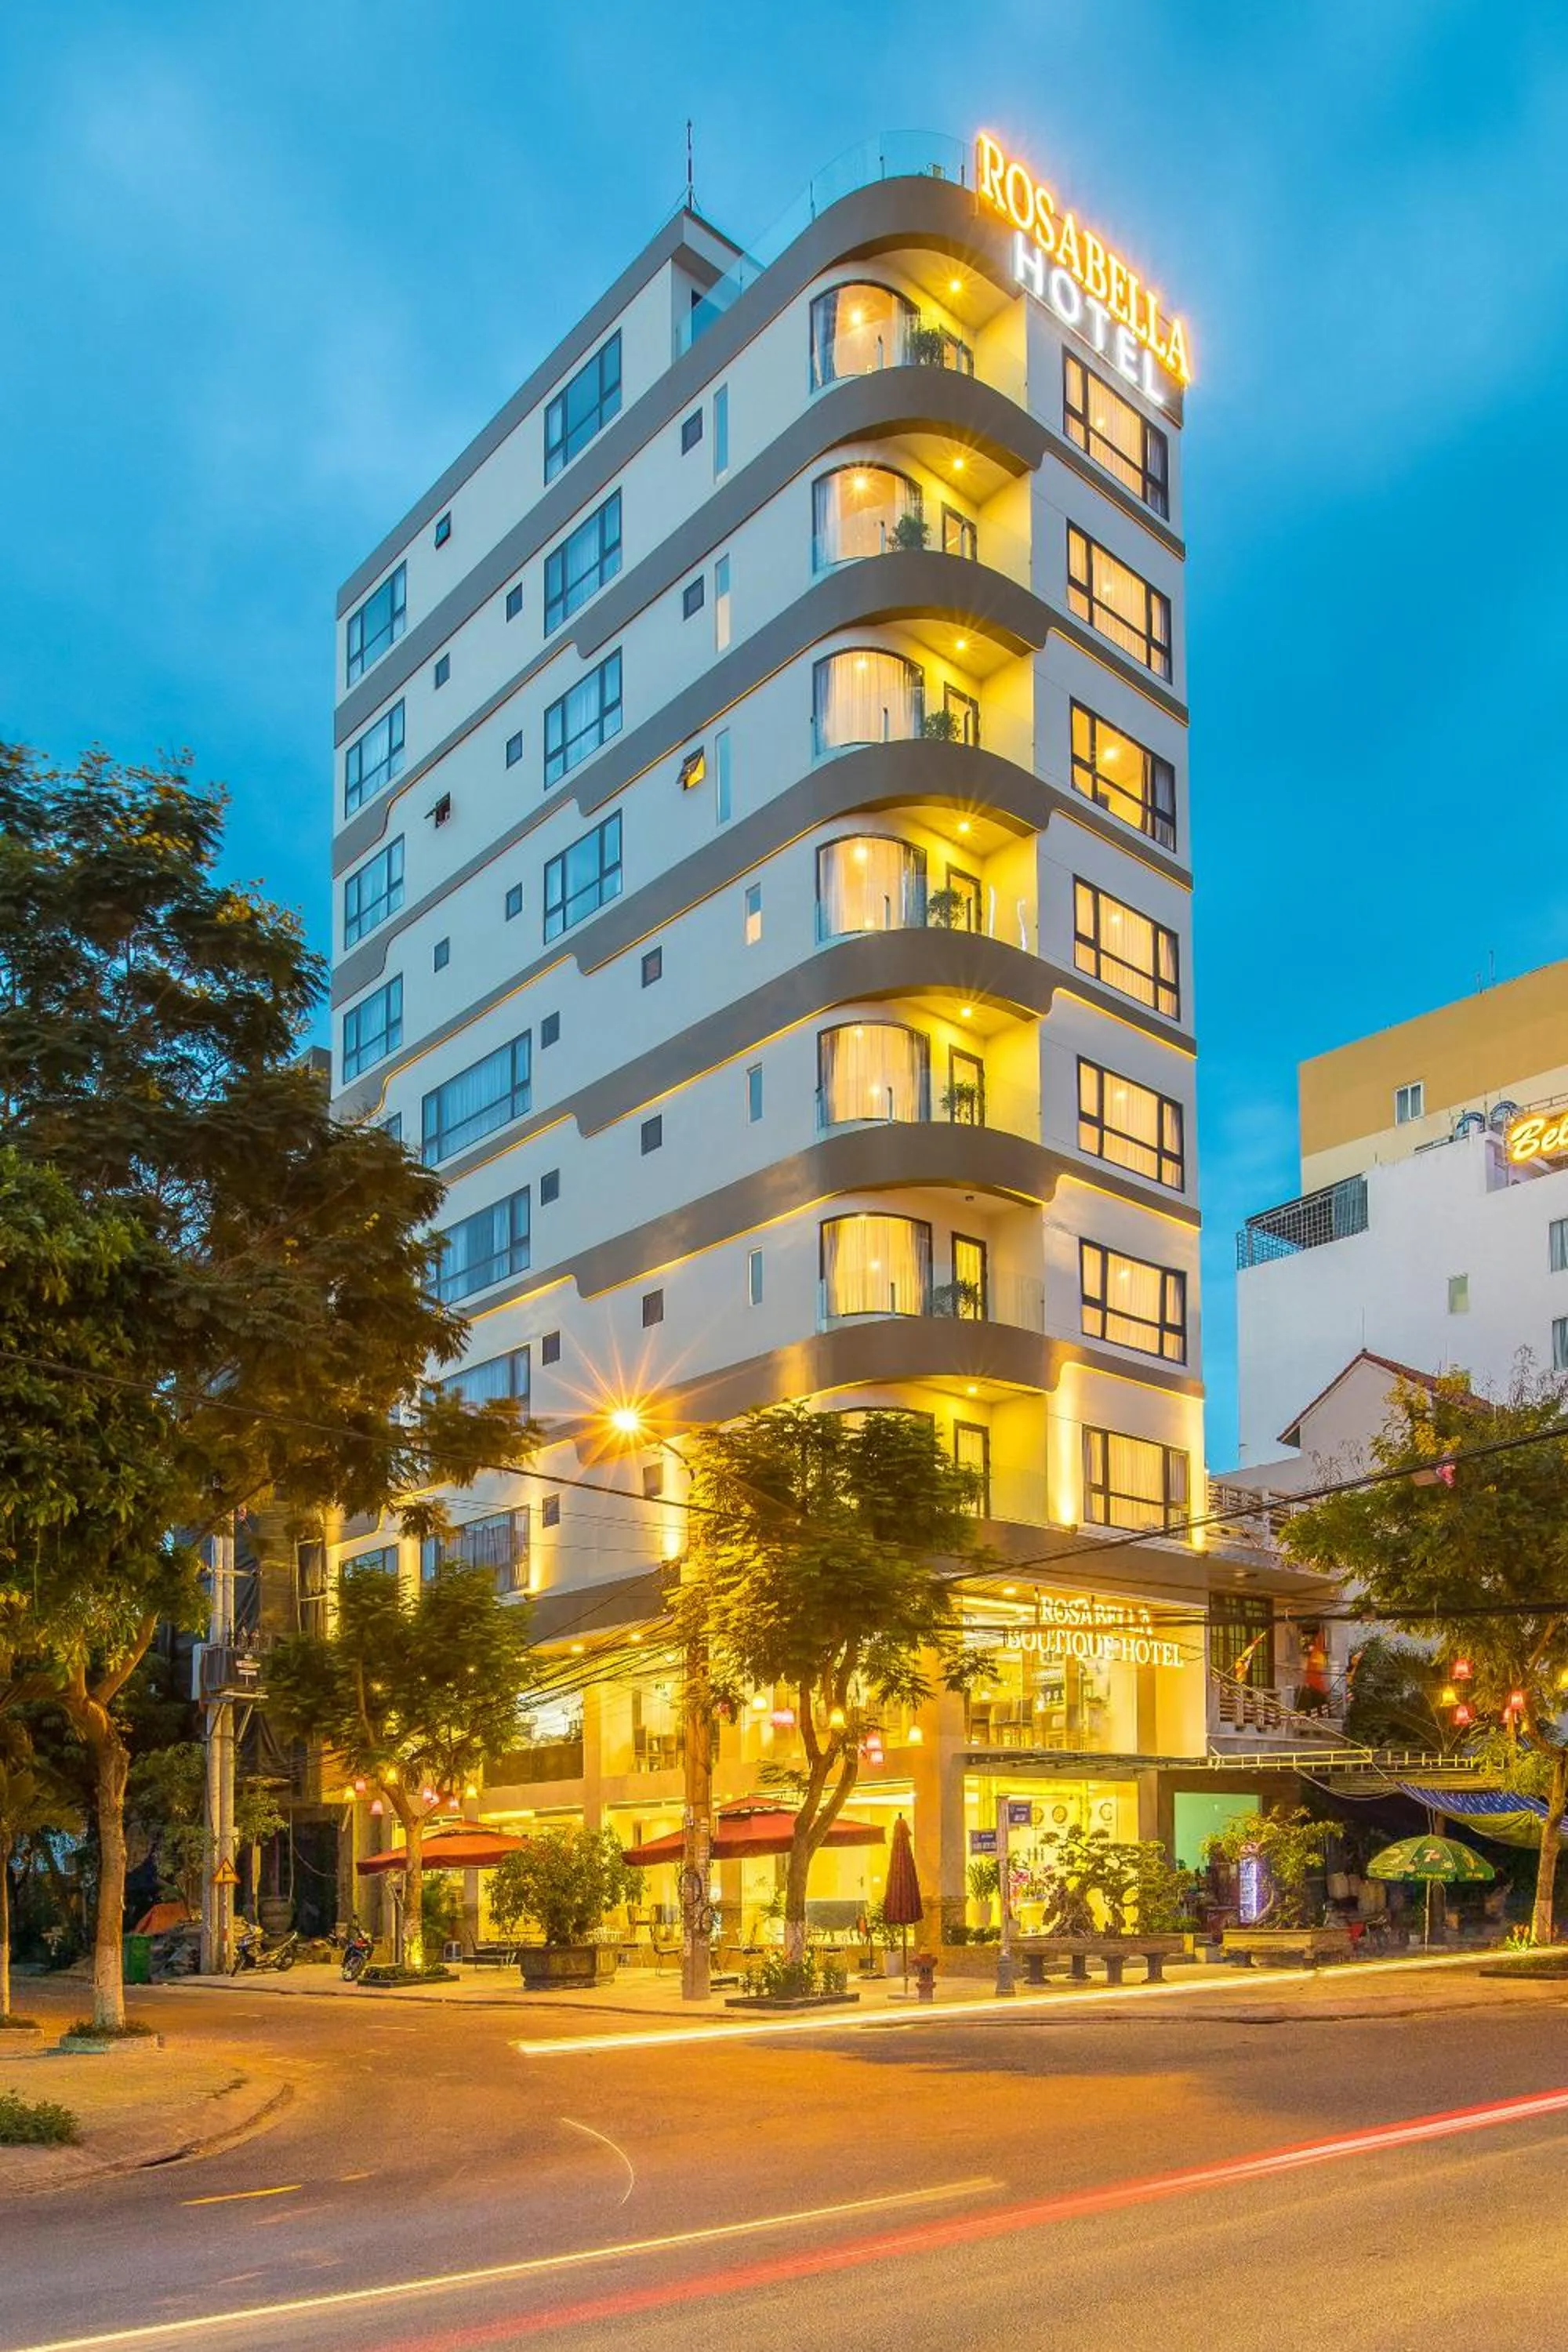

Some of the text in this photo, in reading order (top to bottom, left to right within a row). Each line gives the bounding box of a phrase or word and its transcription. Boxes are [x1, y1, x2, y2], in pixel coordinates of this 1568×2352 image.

[978, 131, 1191, 384] ROSABELLA
[1014, 230, 1165, 405] HOTEL
[1121, 1635, 1185, 1668] HOTEL
